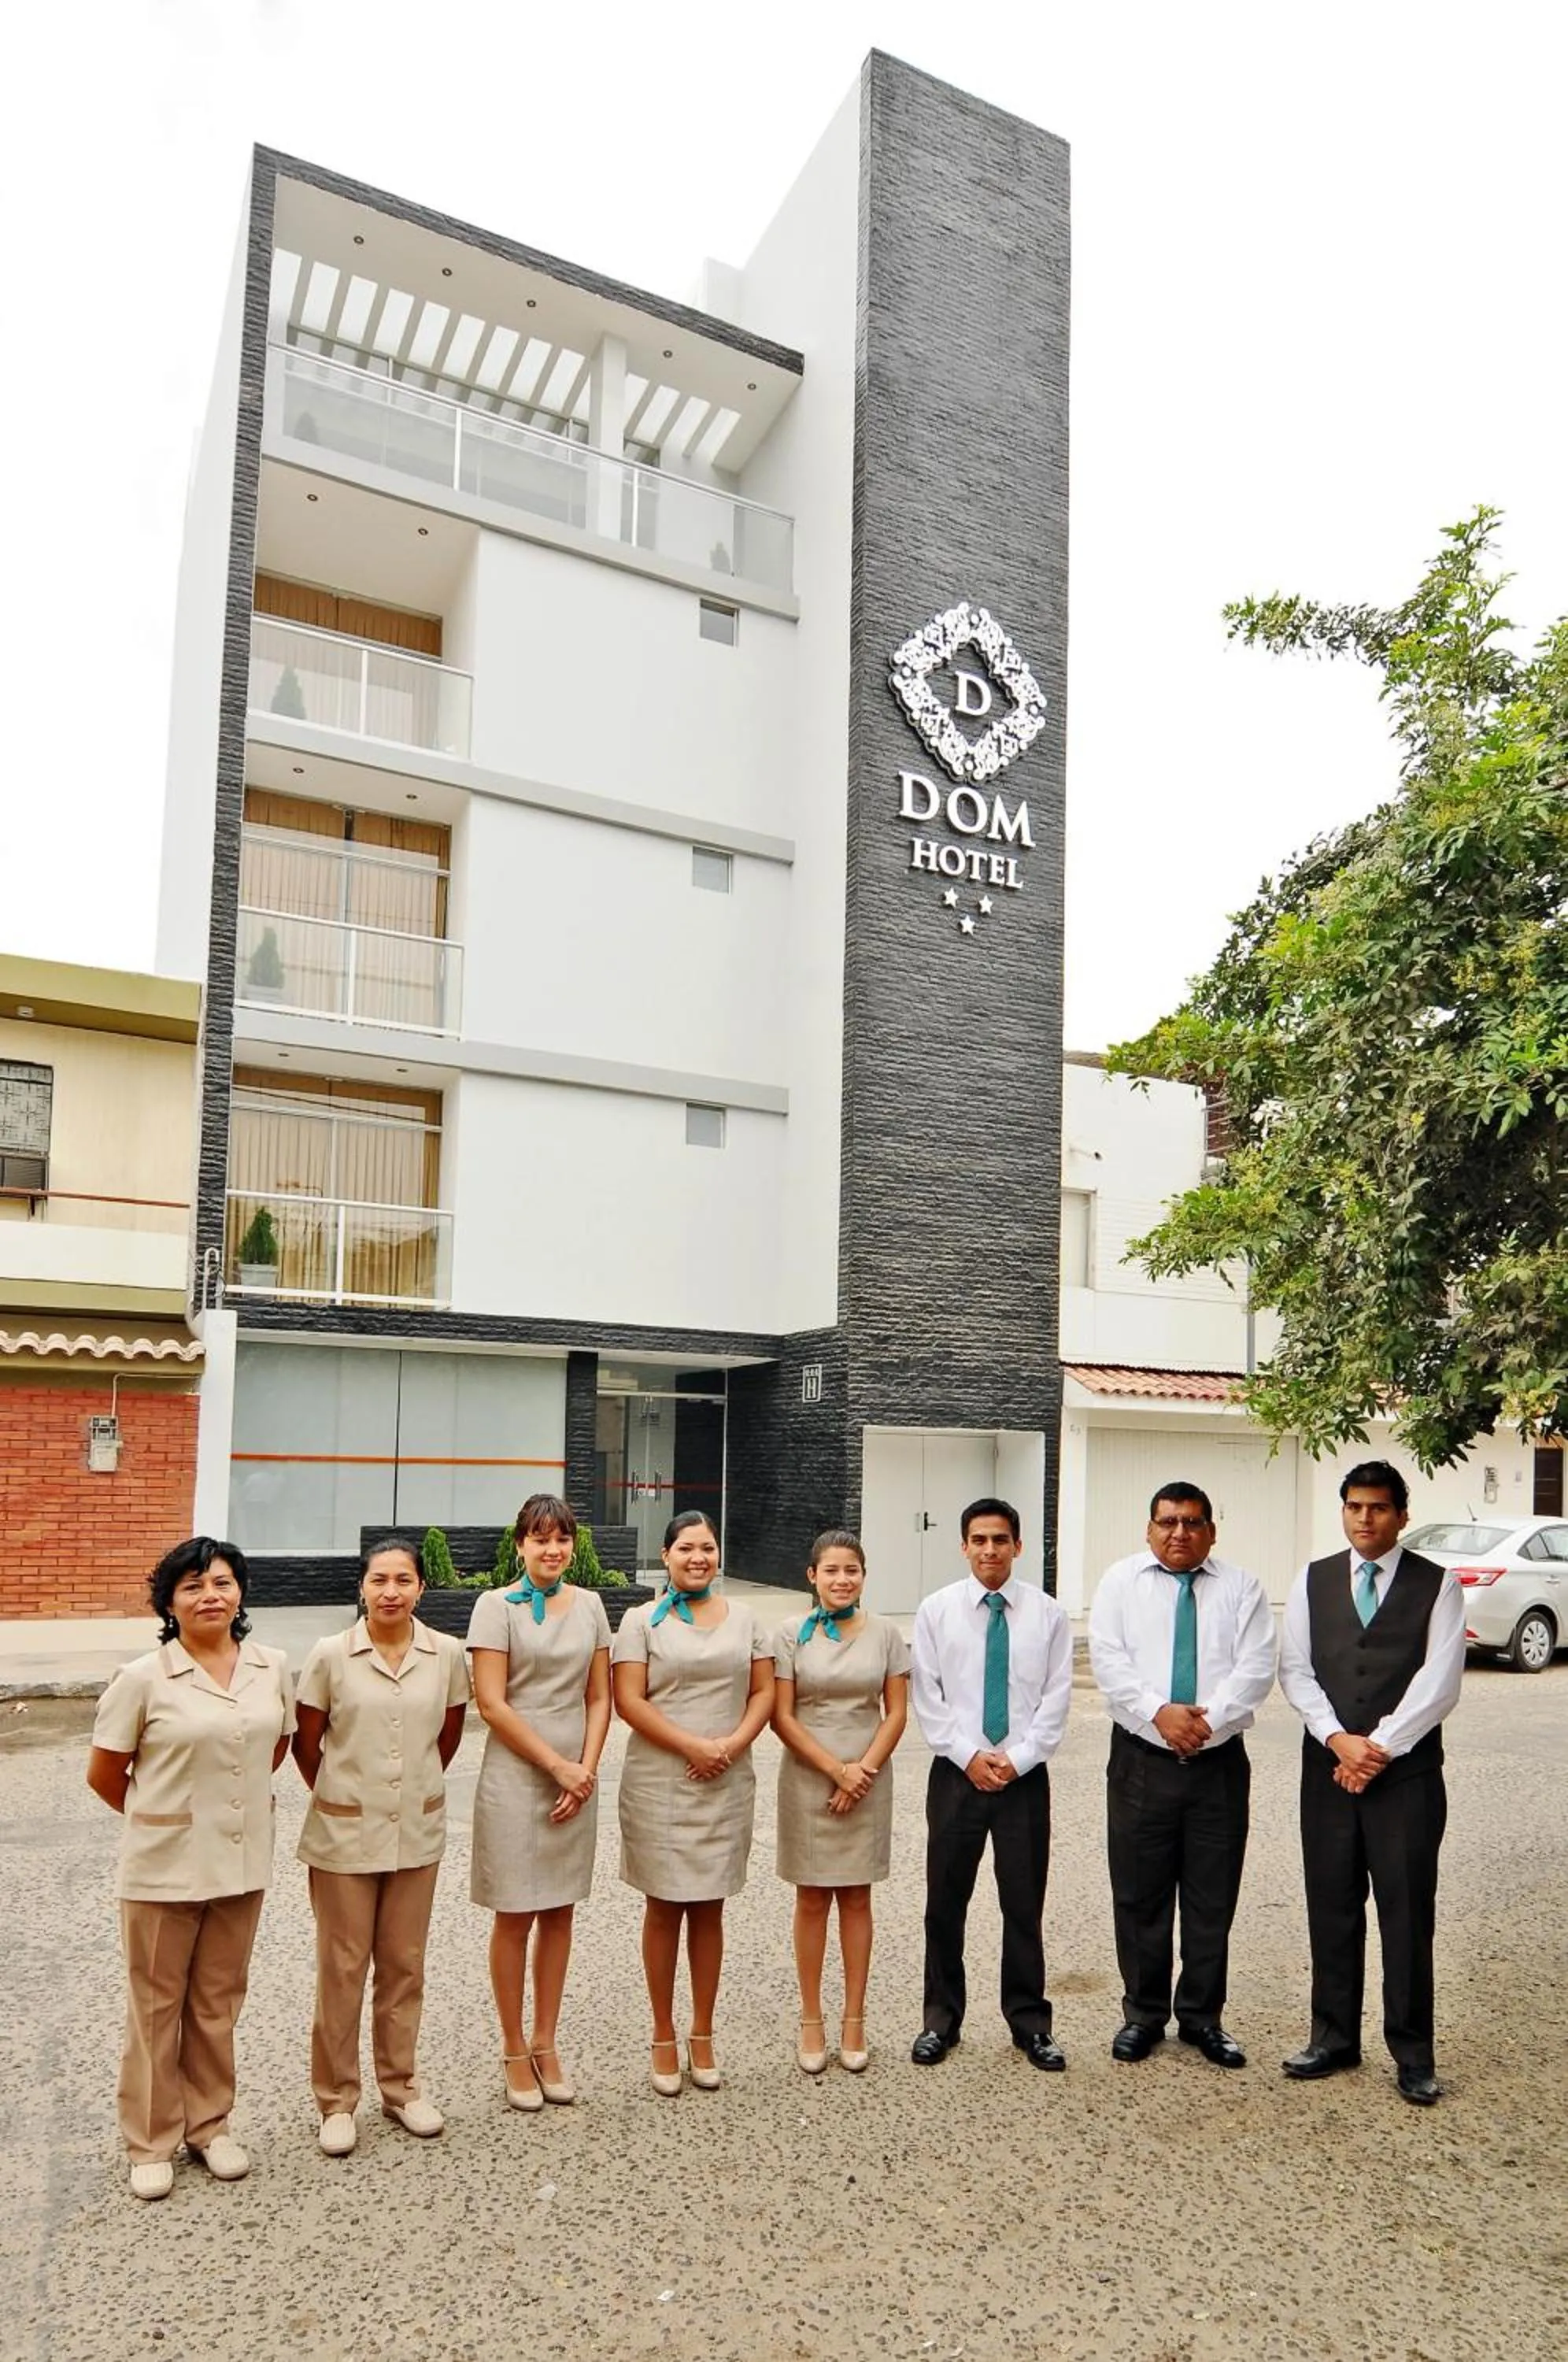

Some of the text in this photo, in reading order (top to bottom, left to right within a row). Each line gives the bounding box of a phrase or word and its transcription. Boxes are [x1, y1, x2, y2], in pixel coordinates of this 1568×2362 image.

[954, 670, 993, 716] D
[898, 769, 1037, 848] DOM
[911, 837, 1025, 890] HOTEL
